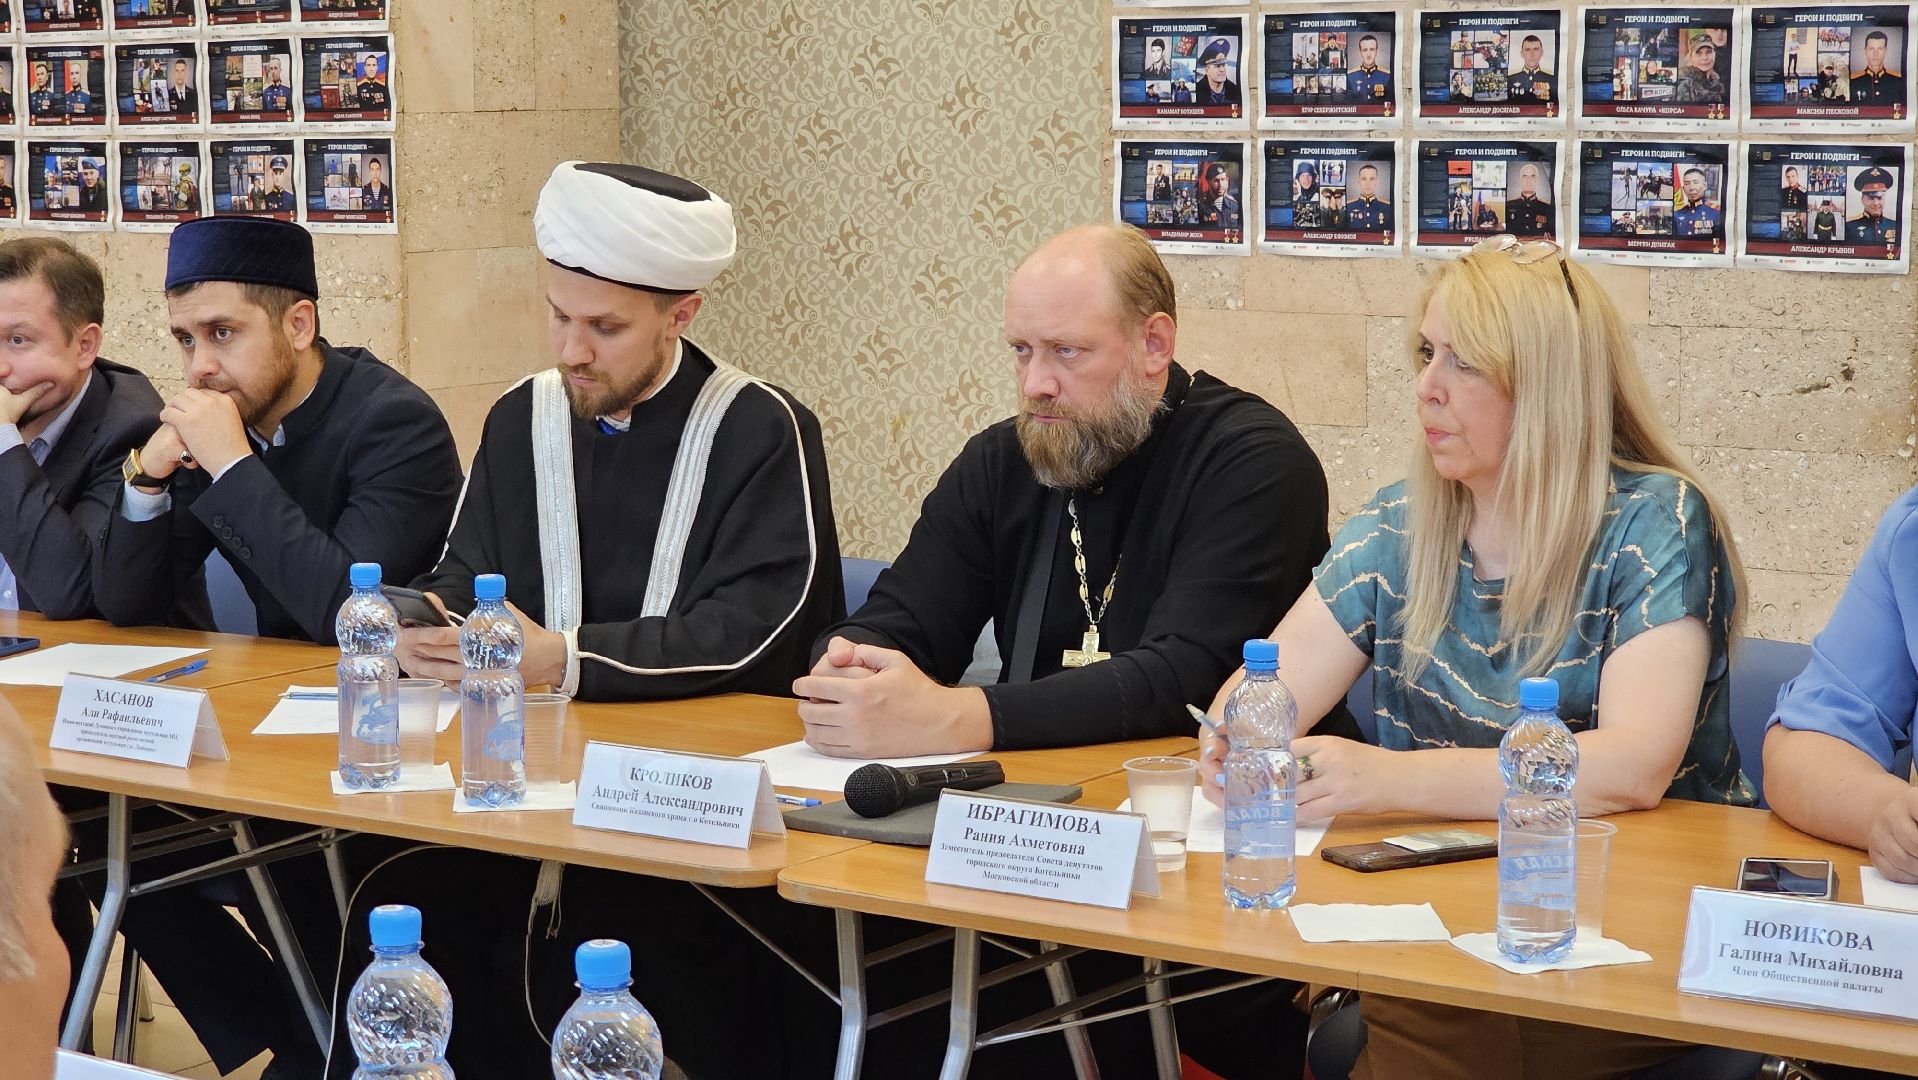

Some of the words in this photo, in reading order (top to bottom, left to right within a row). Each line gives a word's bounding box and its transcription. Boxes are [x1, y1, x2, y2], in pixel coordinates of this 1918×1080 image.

[1625, 15, 1647, 23] ГЕРОИ
[1648, 15, 1654, 23] И
[1655, 15, 1690, 23] ПОДВИГИ
[1795, 14, 1818, 22] ГЕРОИ
[1819, 14, 1825, 22] И
[1826, 14, 1863, 22] ПОДВИГИ
[1790, 152, 1813, 160] ГЕРОИ
[1814, 152, 1821, 160] И
[1822, 152, 1859, 160] ПОДВИГИ
[1790, 246, 1827, 254] АЛЕКСАНДР
[93, 689, 154, 708] ХАСАНОВ
[81, 707, 99, 719] Али
[101, 708, 164, 728] Рафаильевич
[630, 767, 713, 791] КРОЛИКОВ
[592, 784, 639, 804] Андрей
[641, 792, 745, 817] Александрович
[966, 803, 1102, 836] ИБРАГИМОВА
[963, 827, 1006, 845] Рания
[1008, 833, 1086, 856] Ахметовна
[940, 842, 984, 855] Заместитель
[1036, 855, 1063, 866] Совета
[966, 858, 1005, 870] городского
[1007, 864, 1033, 874] округа
[982, 870, 1028, 884] Московской
[1029, 878, 1060, 889] области
[1743, 919, 1874, 951] НОВИКОВА
[1718, 942, 1782, 964] Галина
[1788, 951, 1904, 980] Михайловна
[1732, 965, 1758, 978] Член
[1762, 969, 1840, 989] Общественной
[1842, 982, 1884, 994] палаты
